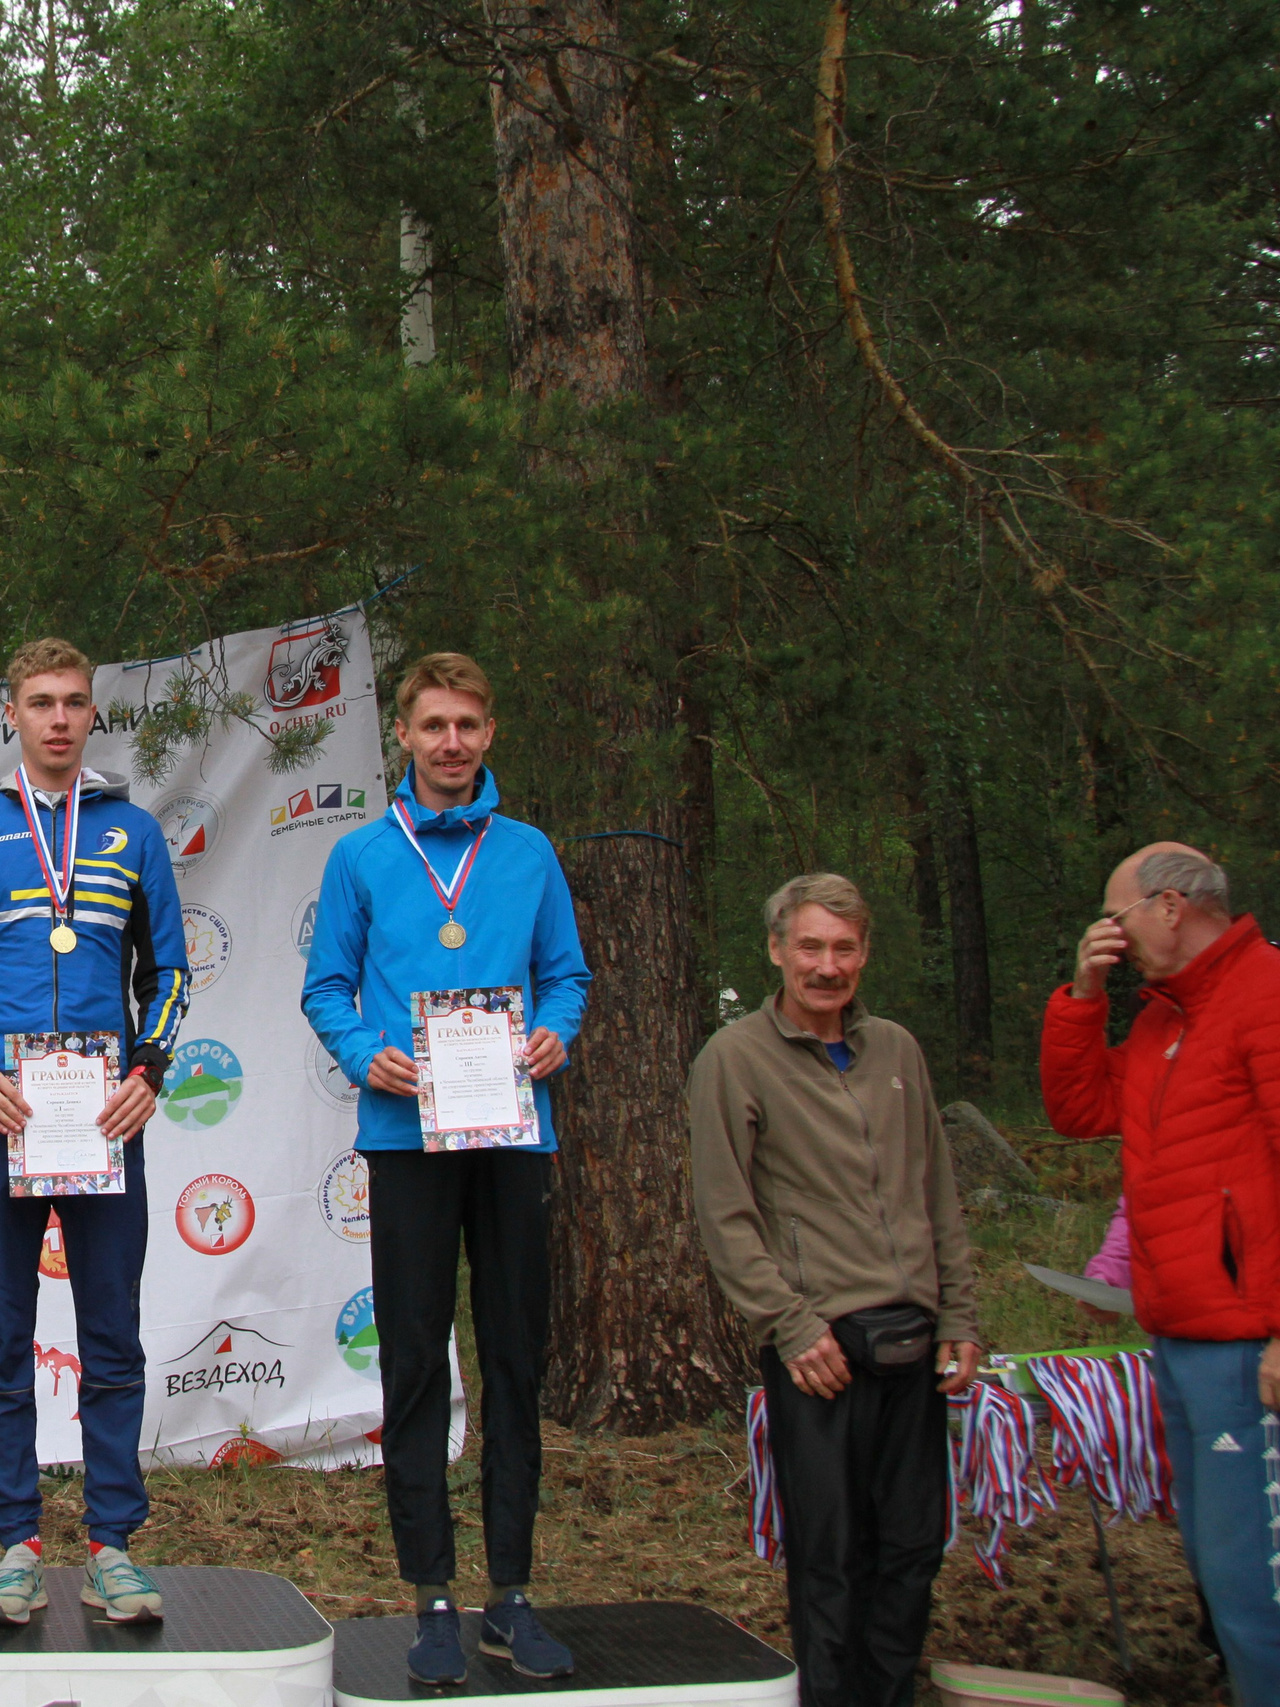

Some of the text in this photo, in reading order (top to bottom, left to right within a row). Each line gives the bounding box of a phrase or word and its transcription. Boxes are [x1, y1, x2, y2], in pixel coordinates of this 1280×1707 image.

[270, 811, 367, 837] СЕМЕЙНЫЕ СТАРТЫ
[208, 915, 228, 939] СШОР
[437, 1025, 501, 1038] ГРАМОТА
[31, 1070, 95, 1081] ГРАМОТА
[178, 1175, 247, 1208] ГОРНЫЙ КОРОЛЬ
[323, 1173, 333, 1221] Открытое
[340, 1212, 371, 1224] Челяби
[341, 1290, 374, 1326] БУГО
[165, 1358, 285, 1398] ВЕЗДЕХОД
